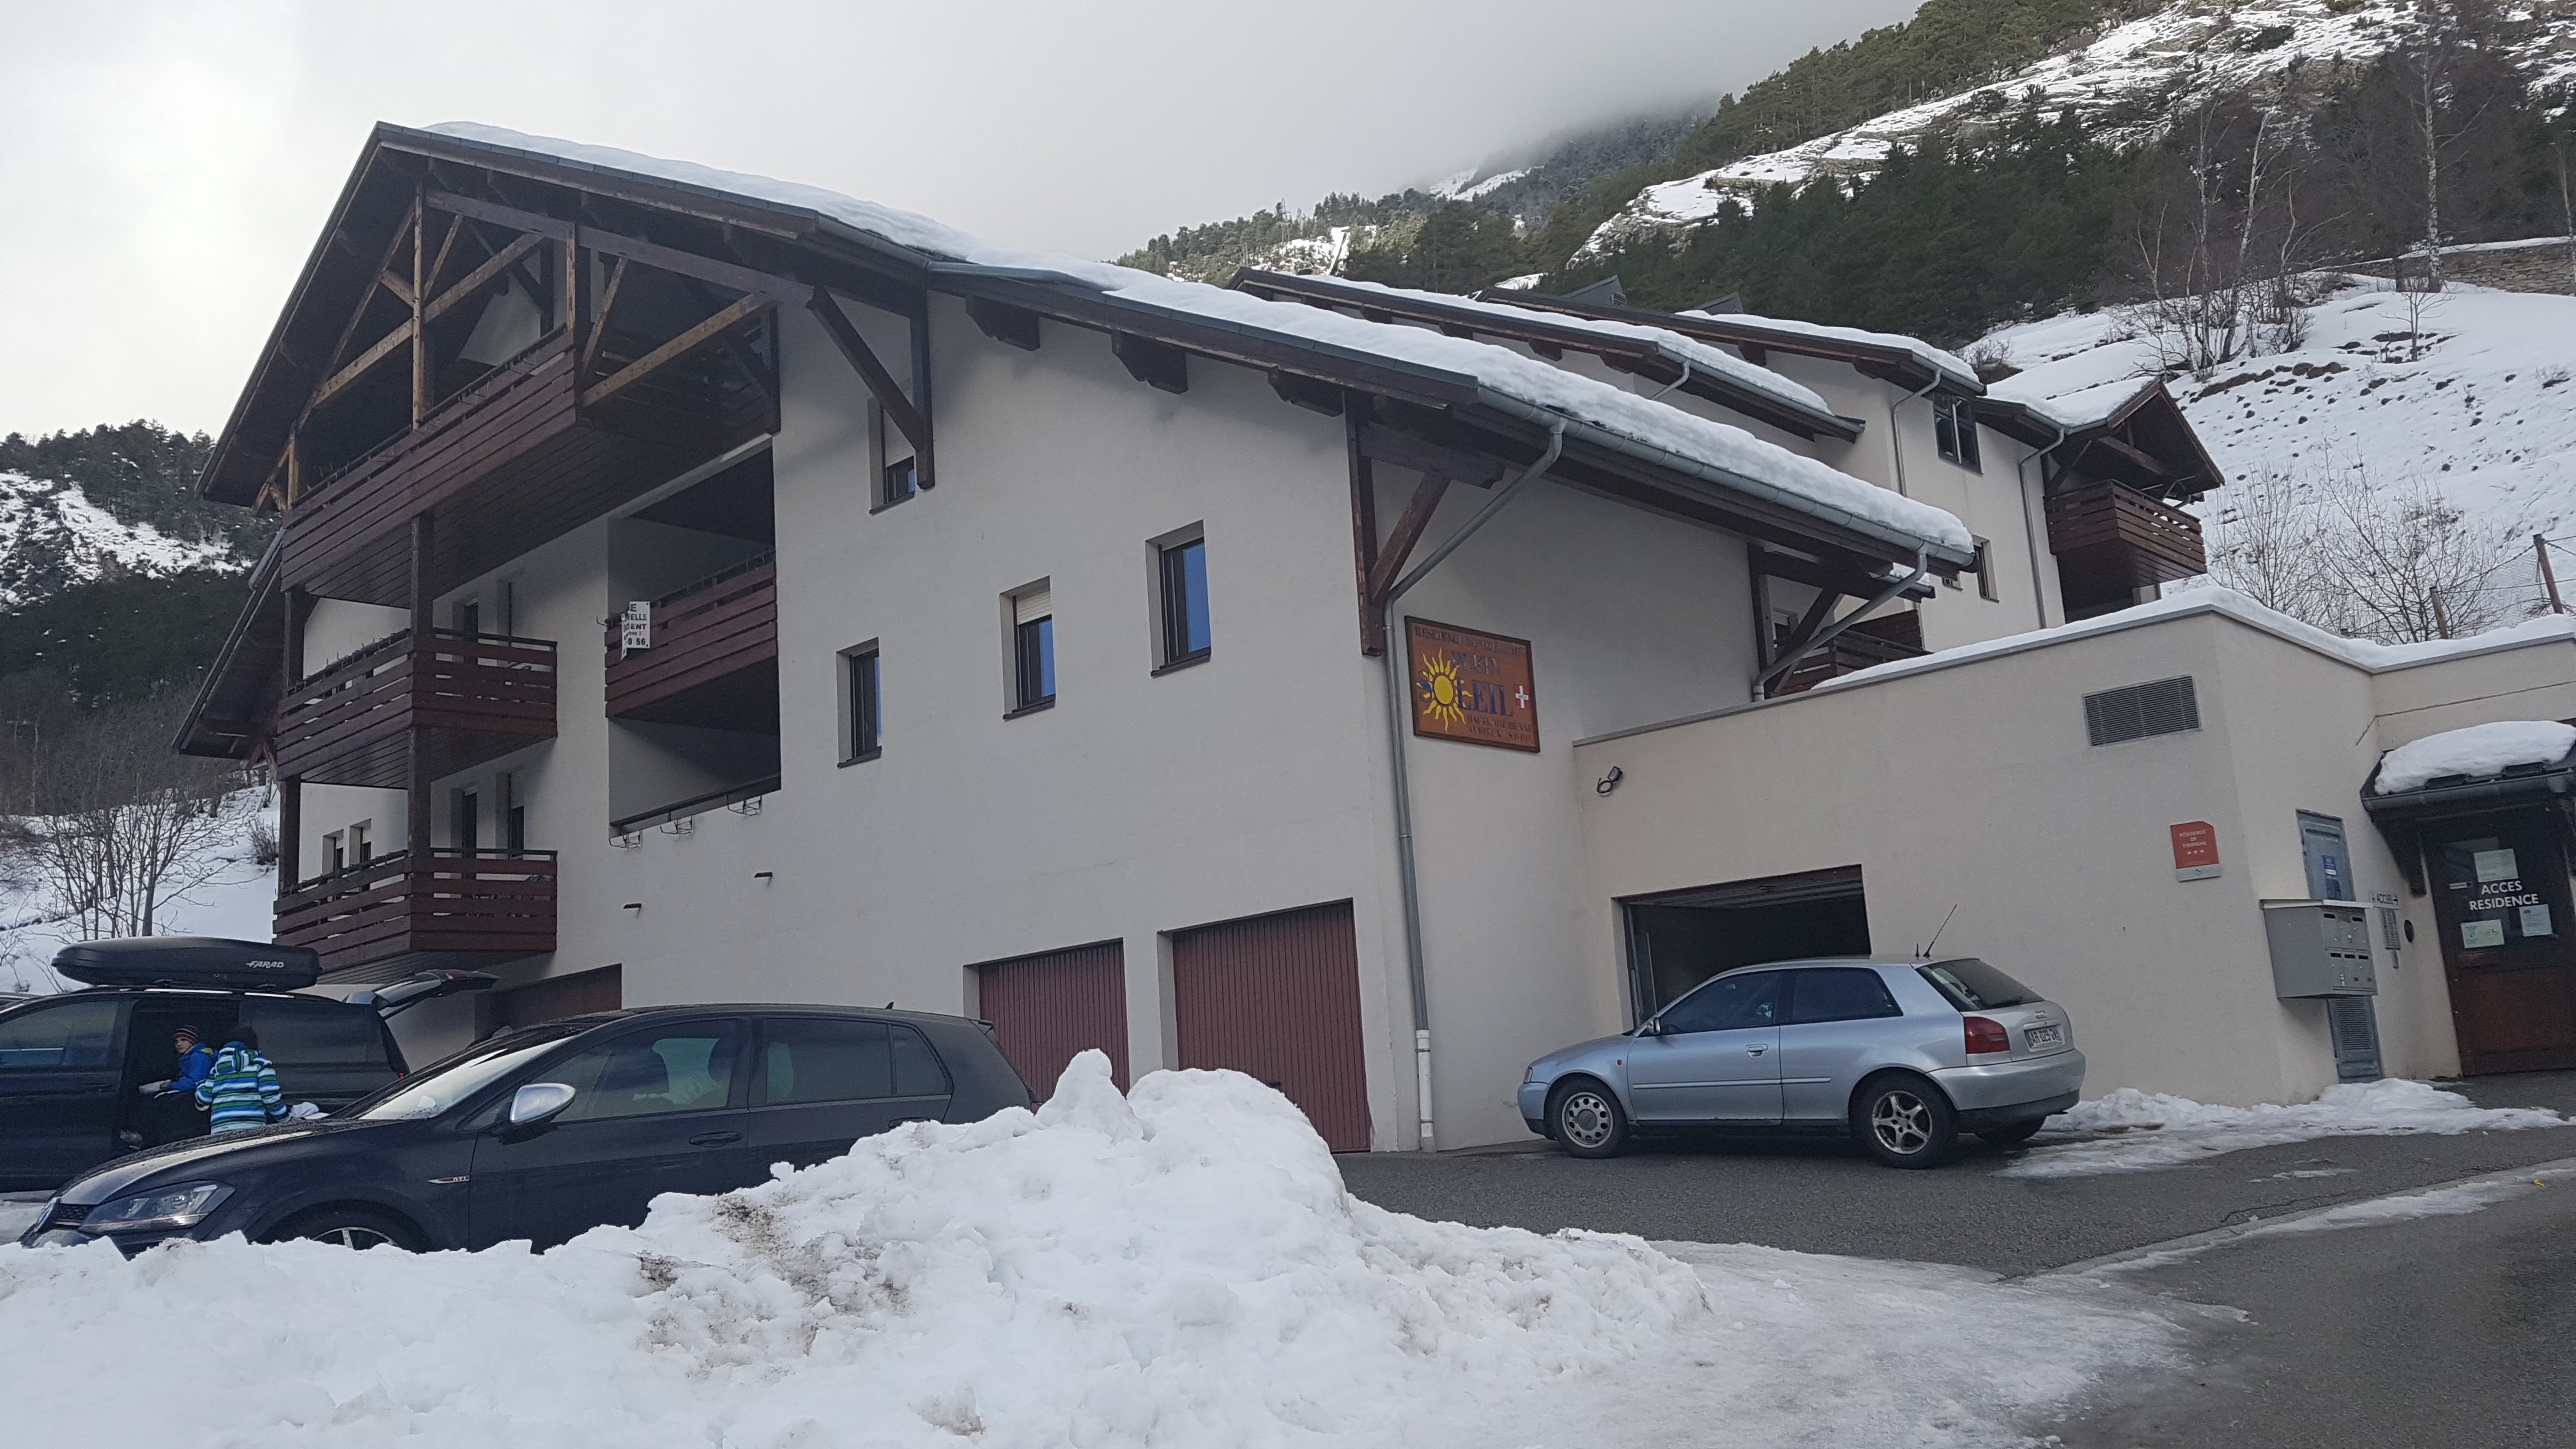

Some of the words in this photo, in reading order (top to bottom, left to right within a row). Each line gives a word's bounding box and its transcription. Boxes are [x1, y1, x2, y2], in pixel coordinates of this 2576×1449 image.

[2481, 880, 2523, 895] ACCES
[2469, 893, 2540, 911] RESIDENCE
[245, 960, 285, 969] FARAD
